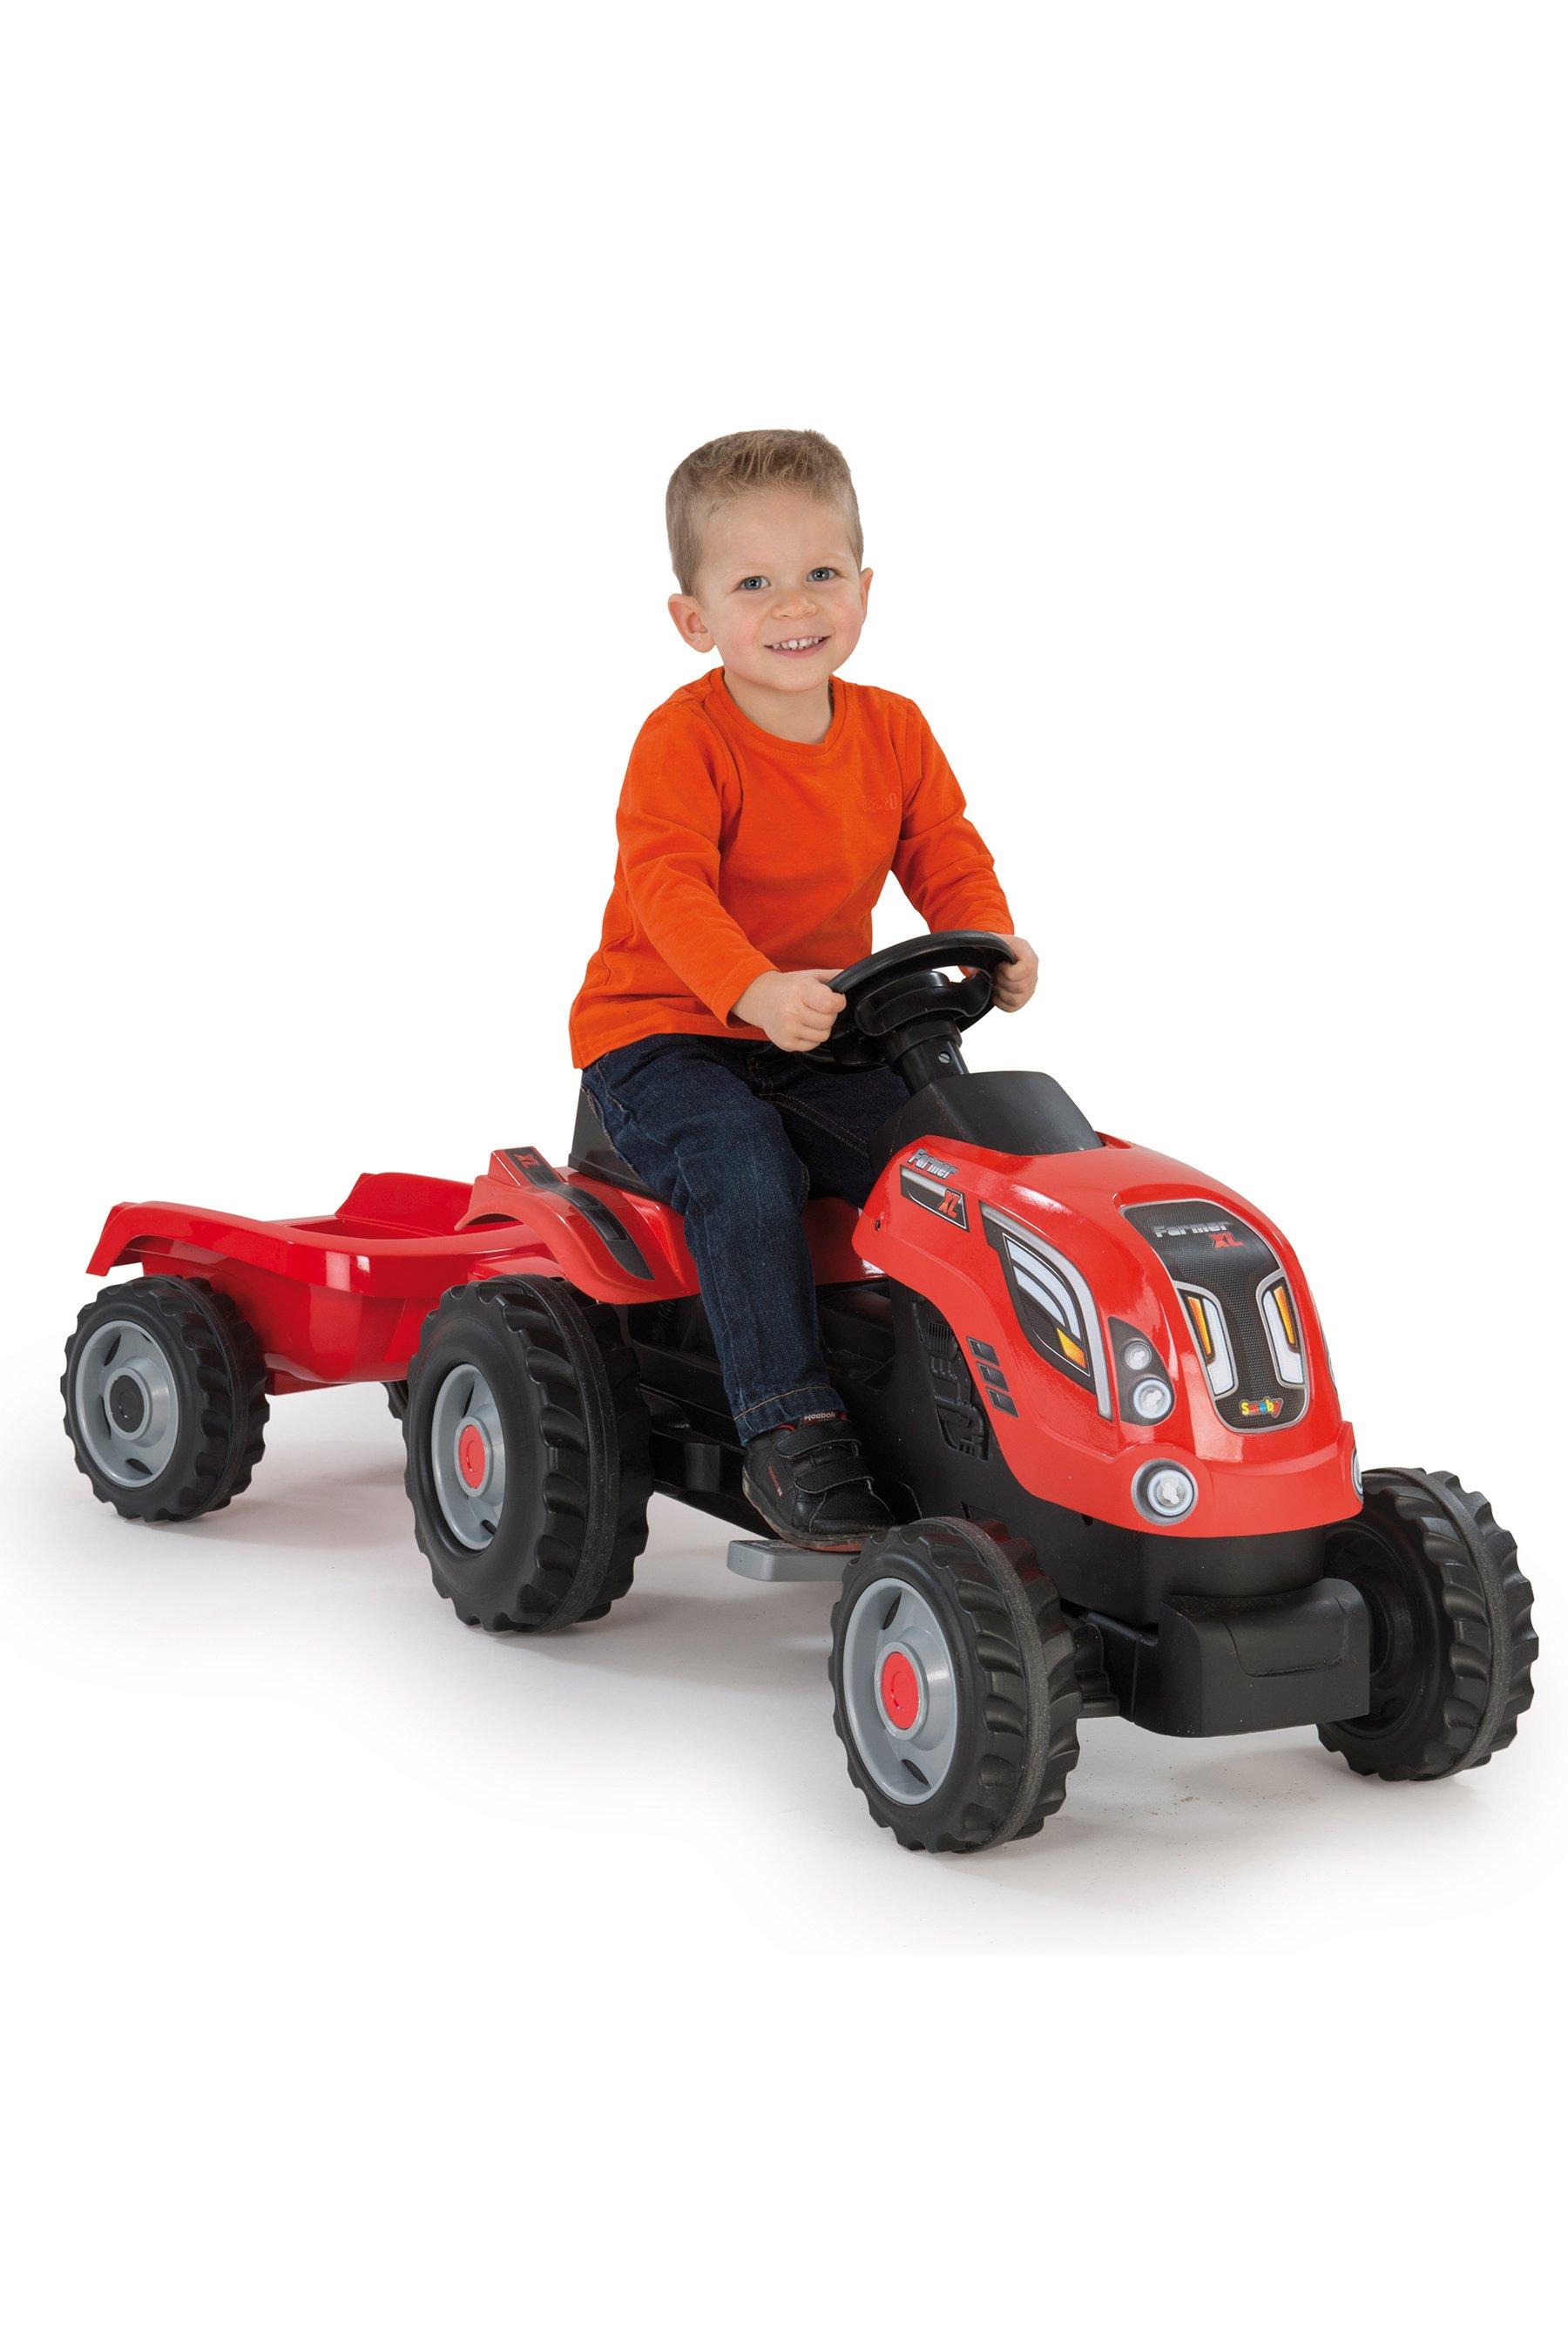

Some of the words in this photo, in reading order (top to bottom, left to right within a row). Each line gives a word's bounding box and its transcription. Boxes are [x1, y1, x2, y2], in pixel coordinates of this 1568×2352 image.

[908, 1148, 957, 1179] Farmer
[937, 1189, 961, 1219] XL
[1152, 1221, 1232, 1238] Farmer
[1207, 1232, 1244, 1249] XL
[1240, 1397, 1283, 1418] Smoby
